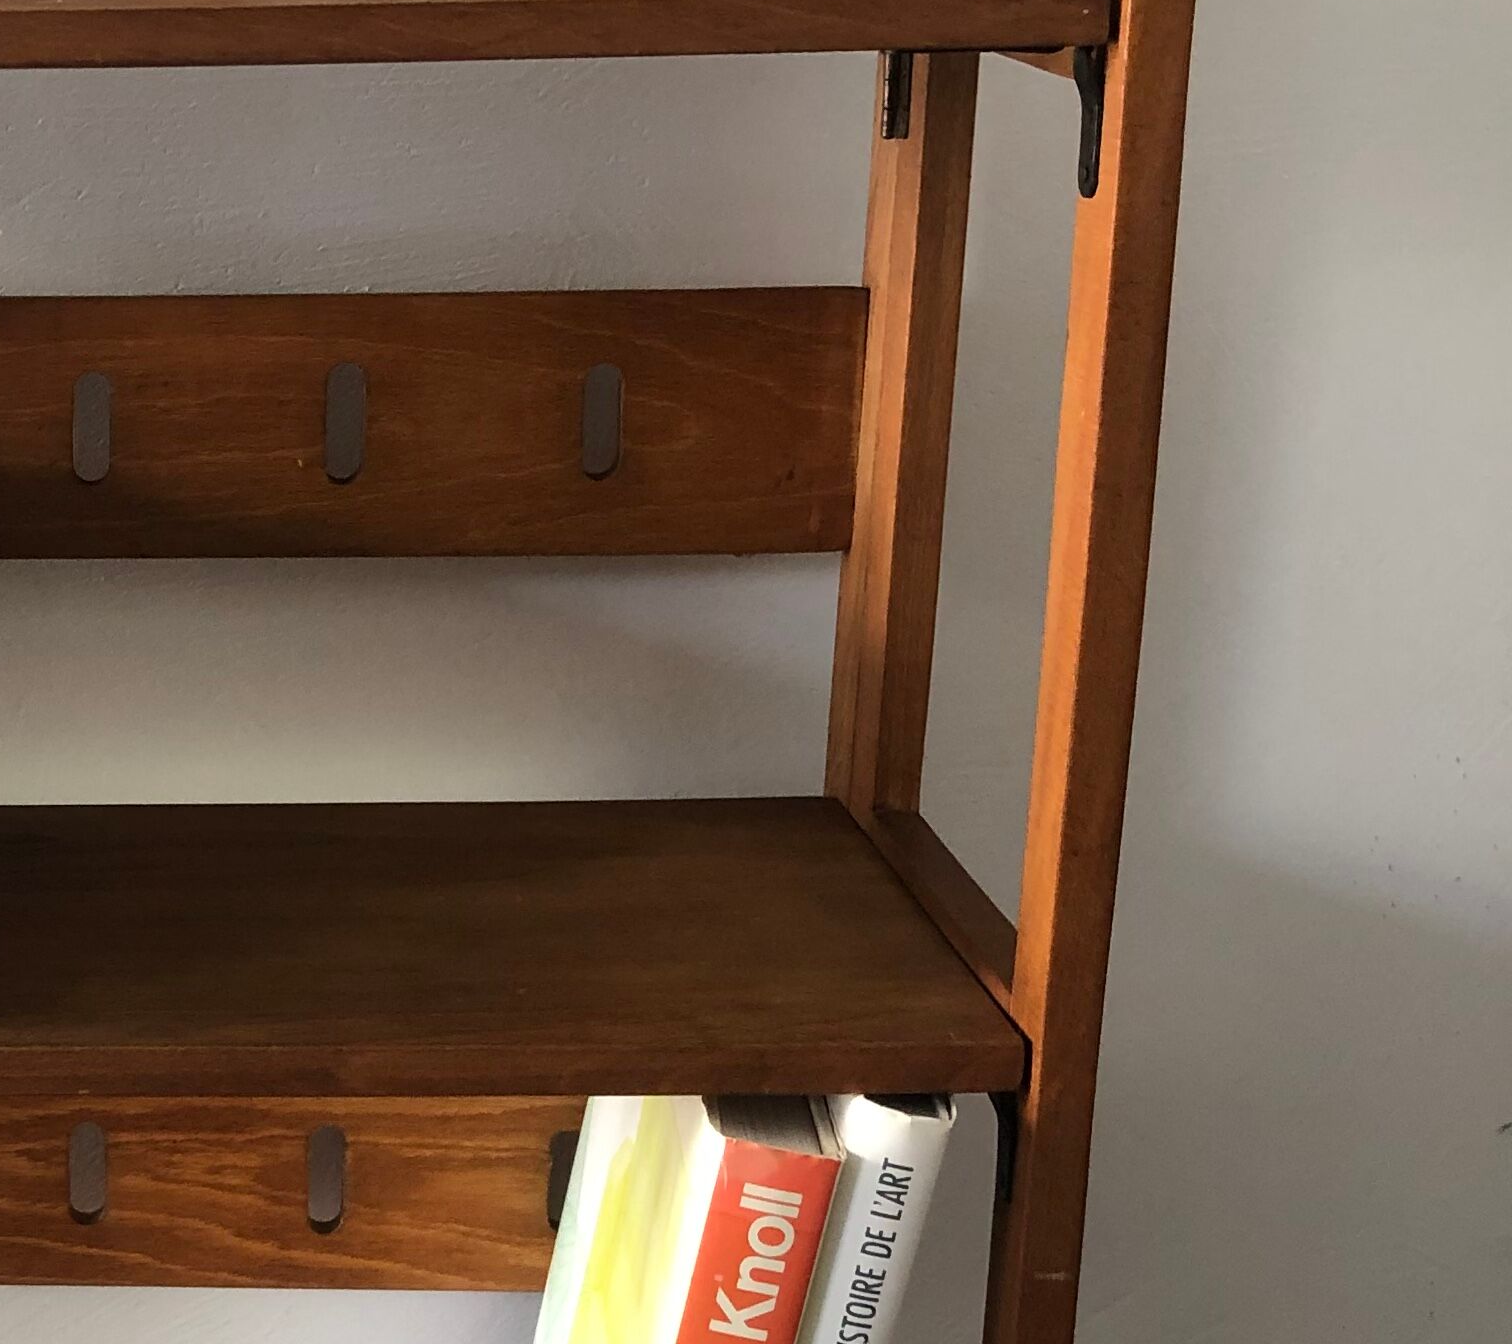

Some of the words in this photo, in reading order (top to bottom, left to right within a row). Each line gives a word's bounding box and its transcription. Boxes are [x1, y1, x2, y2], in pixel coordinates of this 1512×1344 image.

[870, 1157, 915, 1221] L'ART
[708, 1182, 803, 1342] Knoll
[860, 1226, 897, 1259] DE
